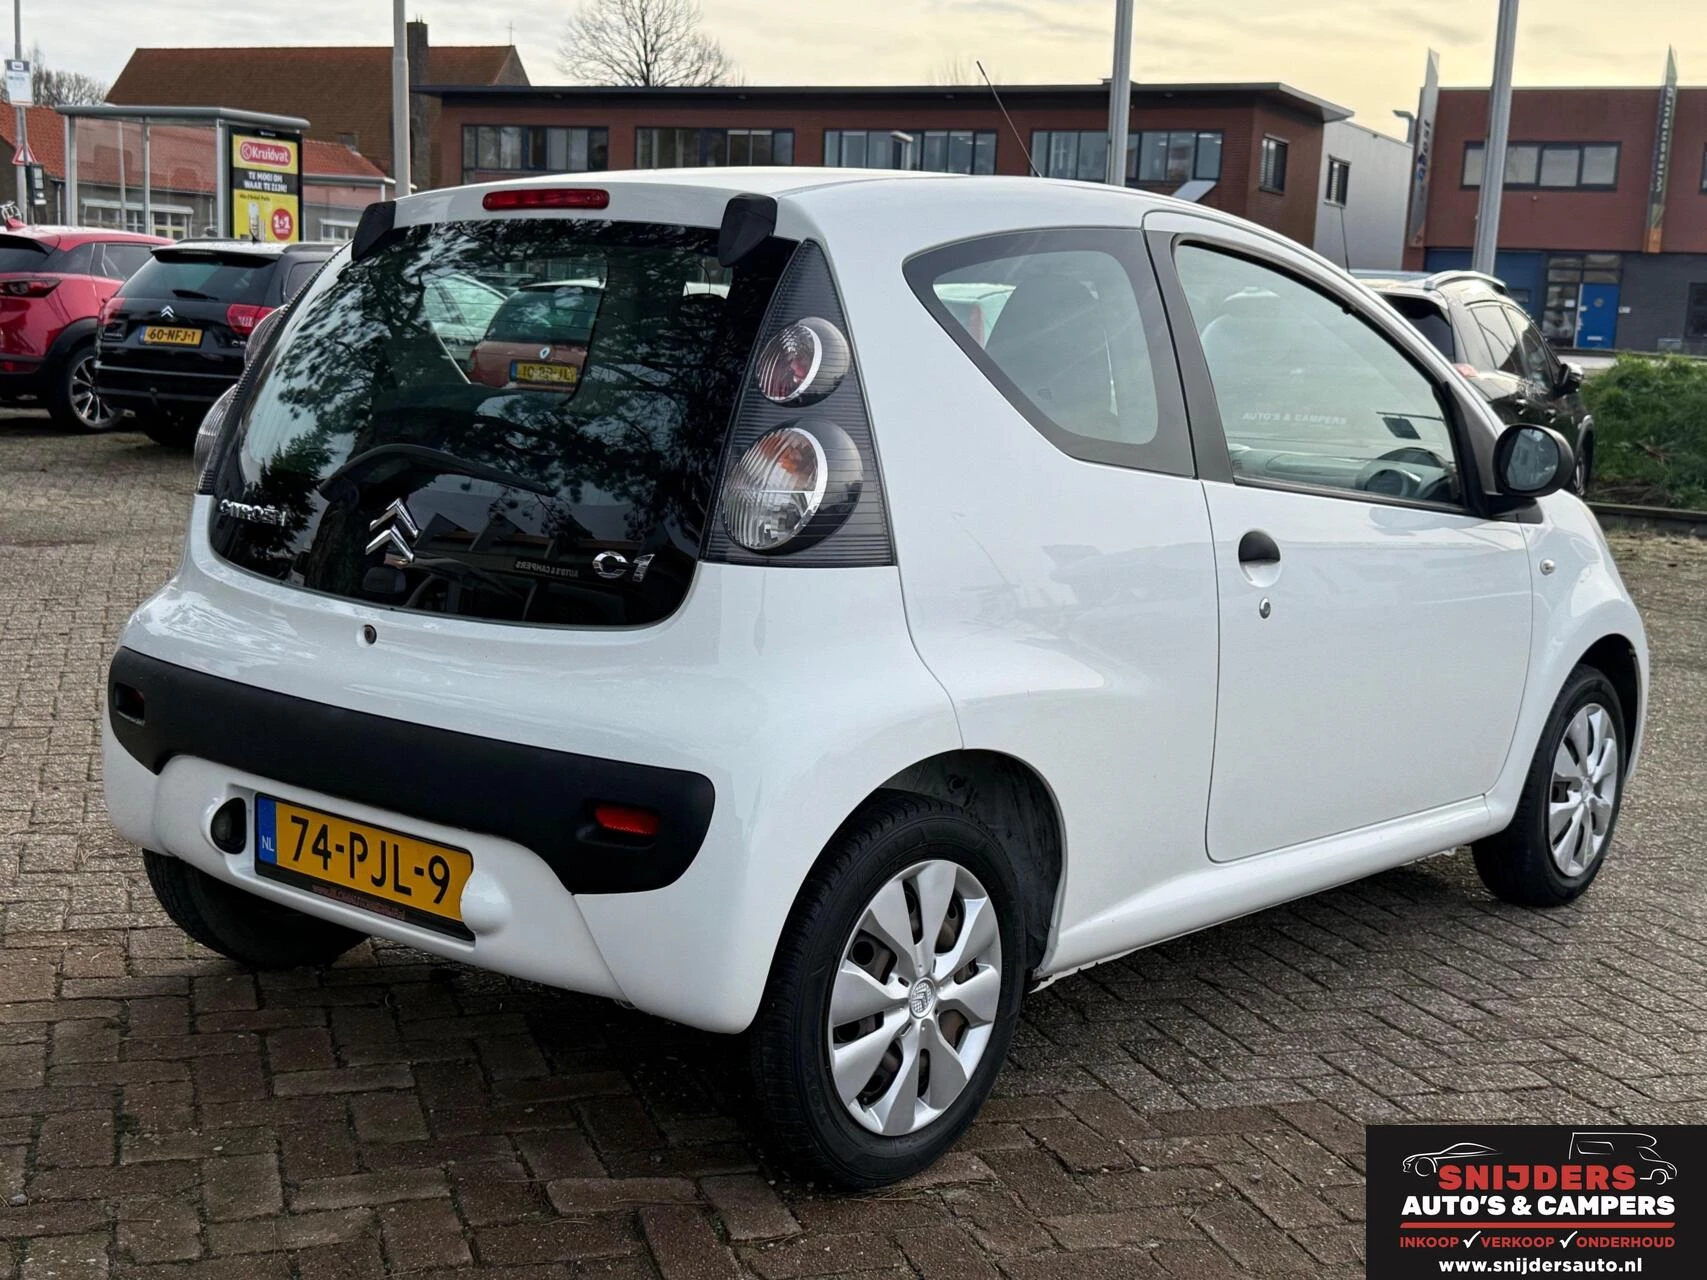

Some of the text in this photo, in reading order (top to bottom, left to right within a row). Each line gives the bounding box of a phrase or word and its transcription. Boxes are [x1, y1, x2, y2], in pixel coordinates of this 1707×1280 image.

[252, 145, 289, 163] Kruidvat
[273, 214, 291, 229] 1+1
[148, 328, 196, 342] 60-NFJ-1
[592, 550, 656, 583] C1
[261, 834, 275, 852] NL
[290, 814, 451, 905] 74-PJL-9
